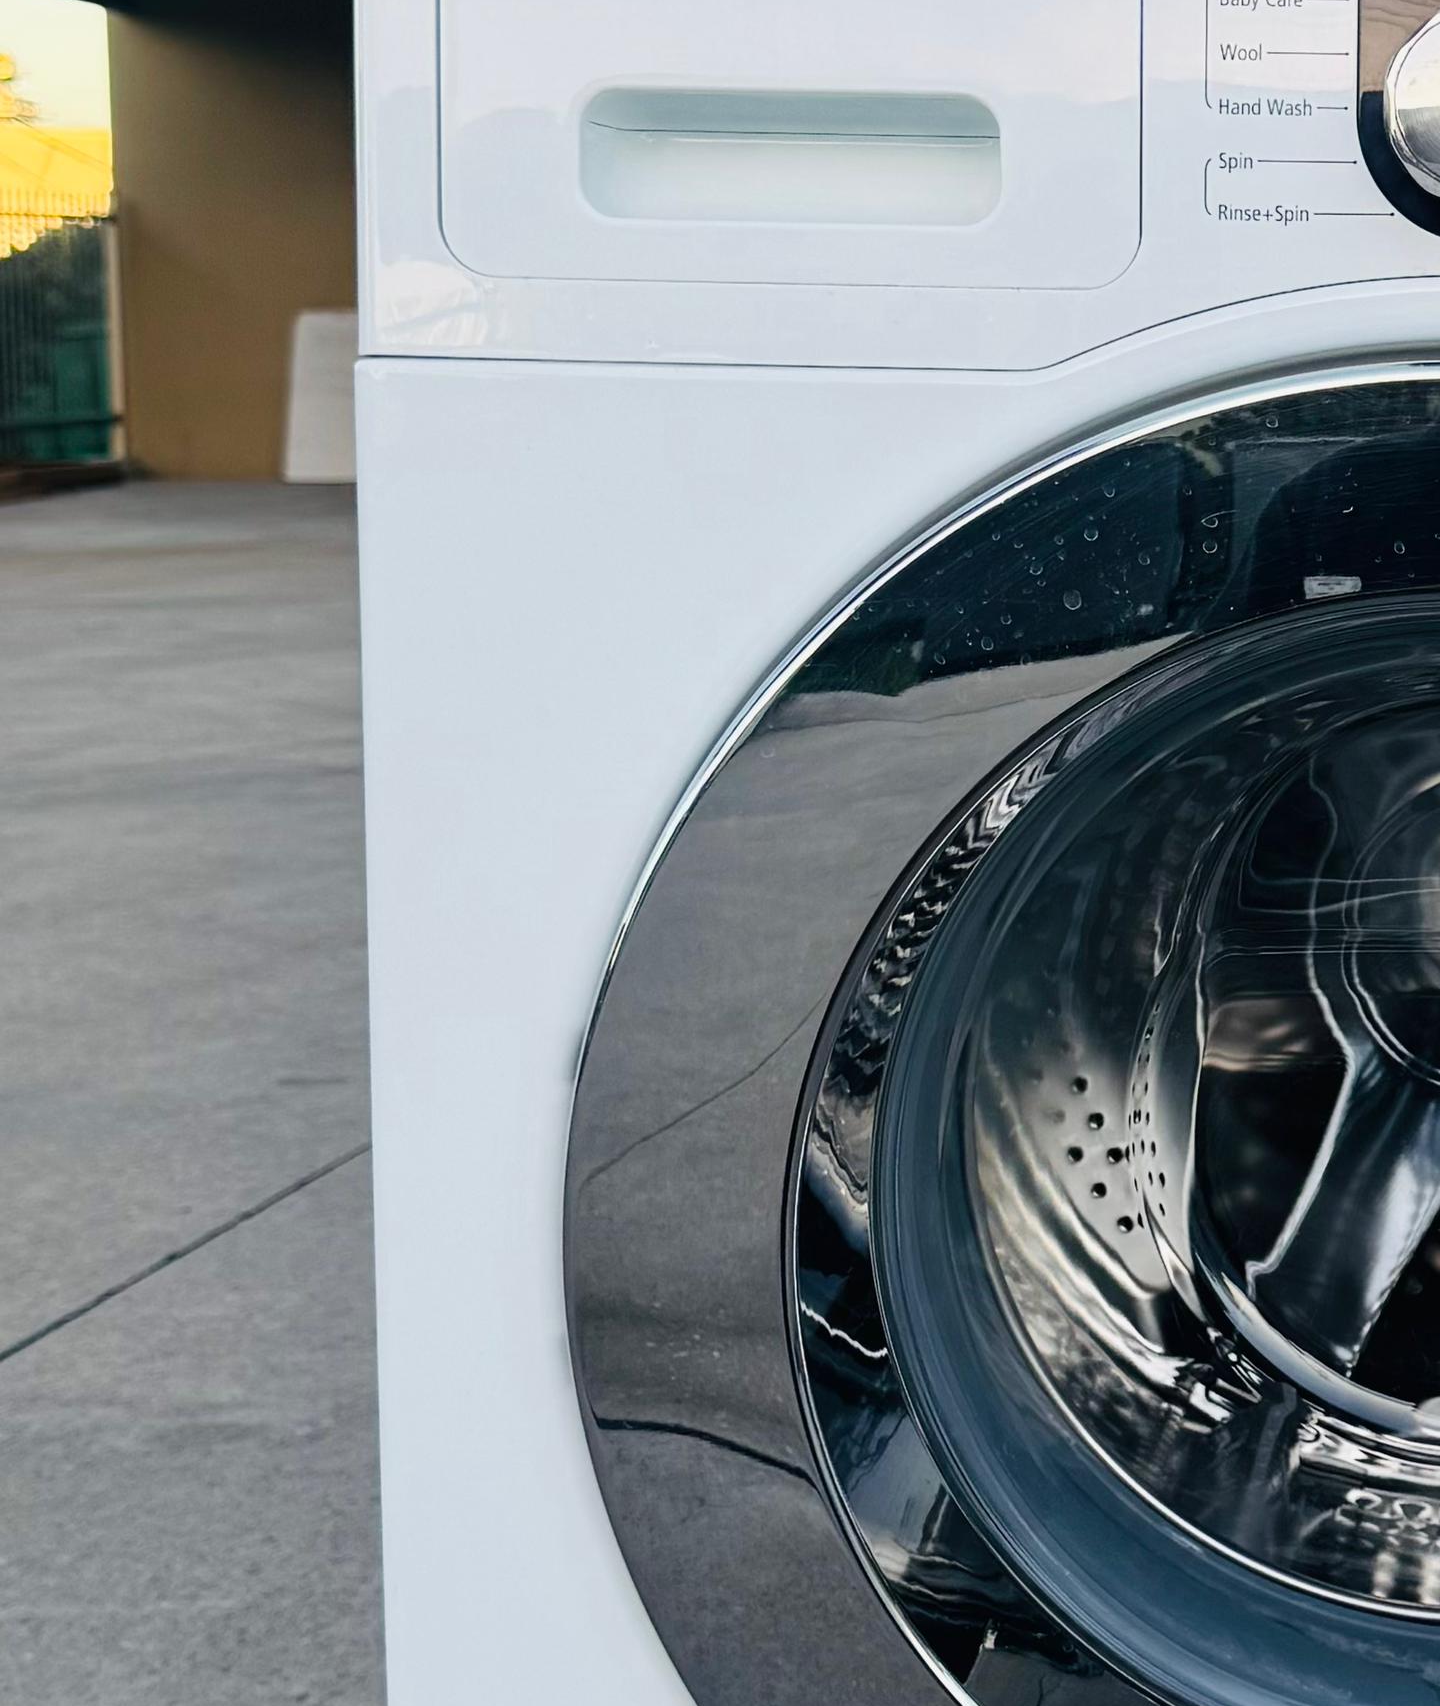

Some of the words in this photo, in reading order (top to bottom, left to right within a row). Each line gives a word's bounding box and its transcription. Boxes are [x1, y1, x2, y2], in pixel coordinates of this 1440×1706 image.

[1219, 43, 1262, 61] Wool
[1219, 97, 1261, 116] Hand
[1266, 98, 1313, 117] Wash
[1218, 152, 1253, 174] Spin
[1218, 204, 1310, 226] Rinse+Spin
